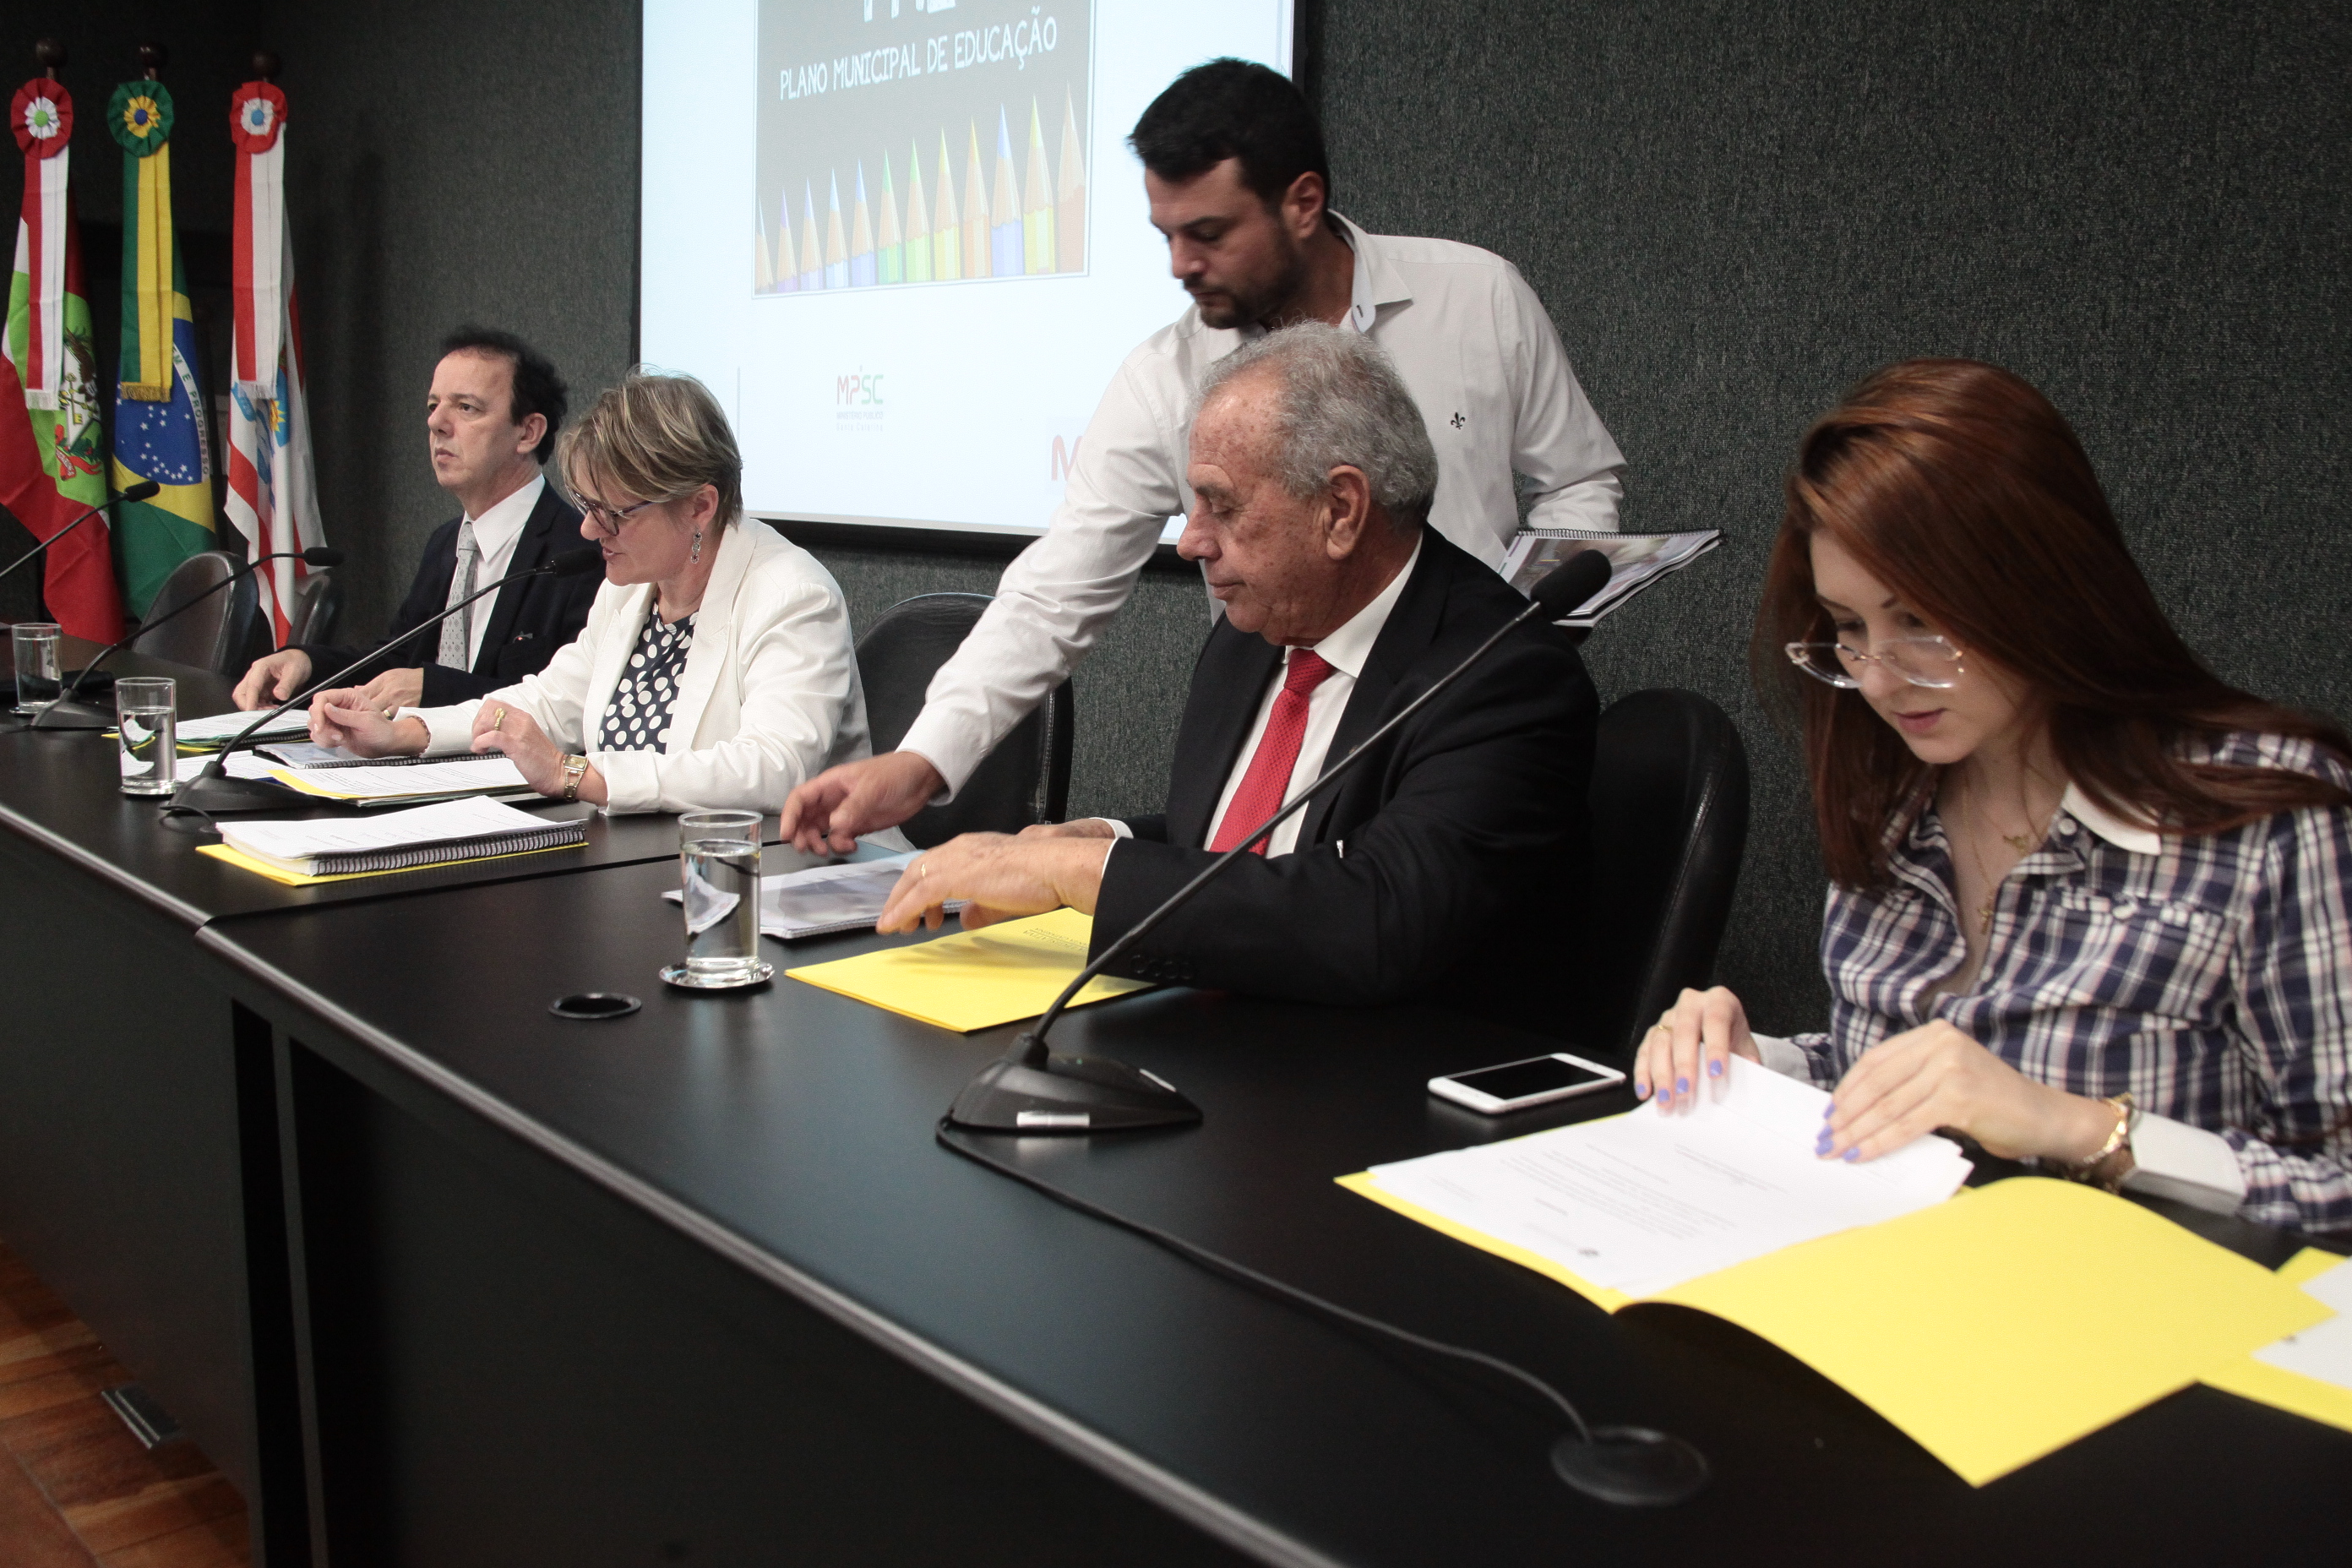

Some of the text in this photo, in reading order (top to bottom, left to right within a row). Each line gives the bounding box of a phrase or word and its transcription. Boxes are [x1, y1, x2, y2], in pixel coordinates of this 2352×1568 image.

[780, 62, 829, 101] PLANO
[833, 42, 922, 91] MUNICIPAL
[927, 35, 949, 74] DE
[955, 5, 1058, 71] EDUCAÇÃO
[837, 373, 885, 406] MPSC
